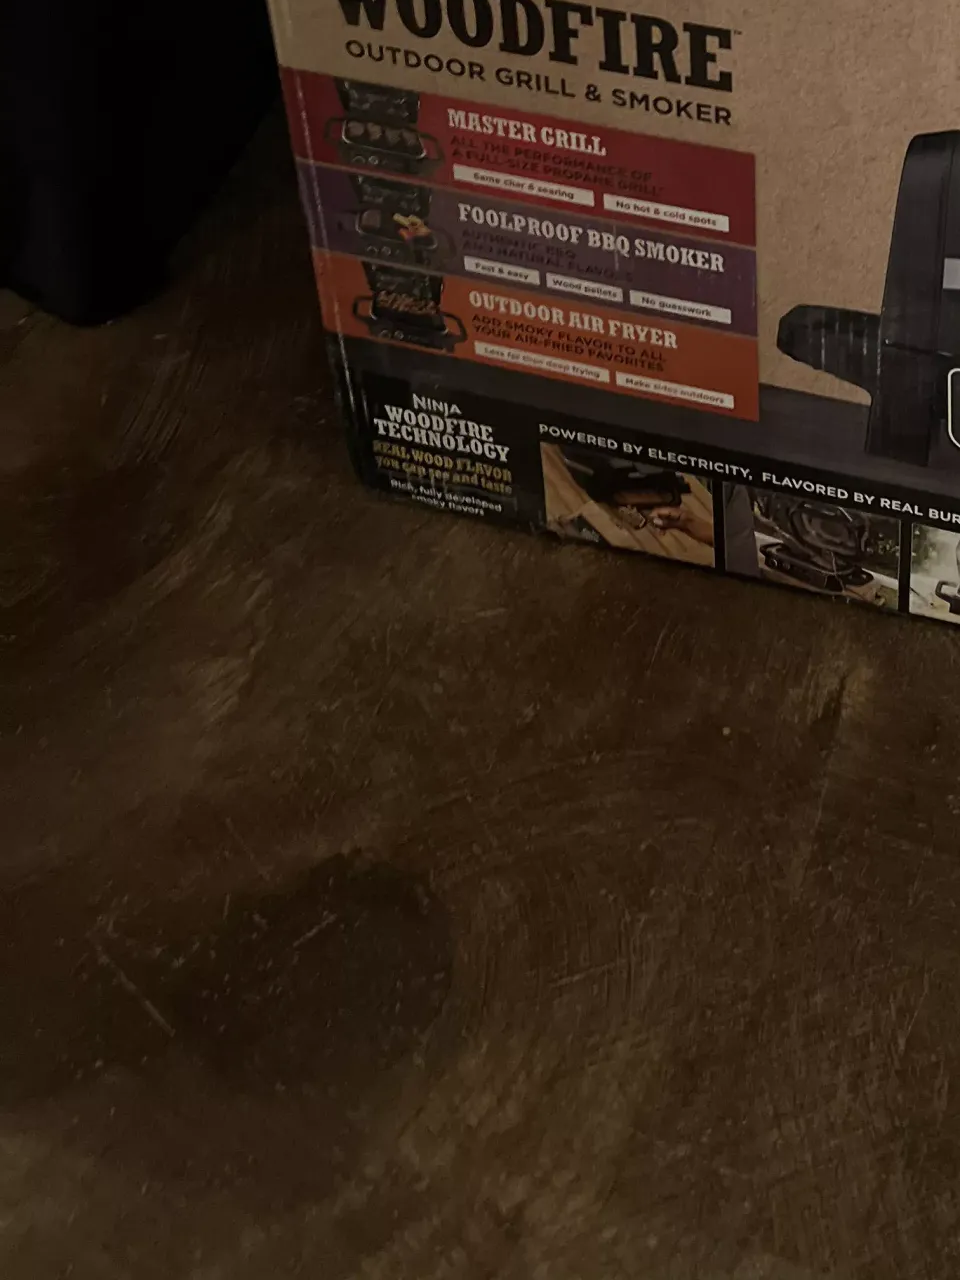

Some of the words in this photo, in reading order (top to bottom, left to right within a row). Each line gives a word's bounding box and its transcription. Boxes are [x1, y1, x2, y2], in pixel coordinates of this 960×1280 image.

[345, 40, 487, 82] OUTDOOR
[495, 67, 576, 98] GRILL
[586, 84, 601, 102] &
[612, 88, 732, 125] SMOKER
[447, 108, 537, 143] MASTER
[540, 127, 607, 156] GRILL
[616, 200, 631, 210] No
[458, 202, 583, 243] FOOLPROOF
[587, 229, 631, 256] BBQ
[634, 238, 724, 272] SMOKER
[468, 290, 565, 325] OUTDOOR
[569, 311, 605, 333] AIR
[608, 319, 678, 349] FRYER
[471, 314, 502, 327] ADD
[506, 320, 554, 340] SMOKY
[559, 330, 613, 350] FLAVOR
[616, 344, 636, 354] TO
[475, 324, 511, 340] YOUR
[515, 333, 584, 355] AIR-FRIED
[384, 404, 493, 443] WOODFIRE
[412, 393, 462, 416] NINJA
[373, 418, 510, 463] TECHNOLOGY
[539, 423, 618, 450] POWERED
[623, 442, 643, 456] BY
[648, 448, 752, 480] ELECTRICITY,
[762, 472, 849, 500] FLAVORED
[853, 491, 876, 506] BY
[880, 498, 924, 517] REAL
